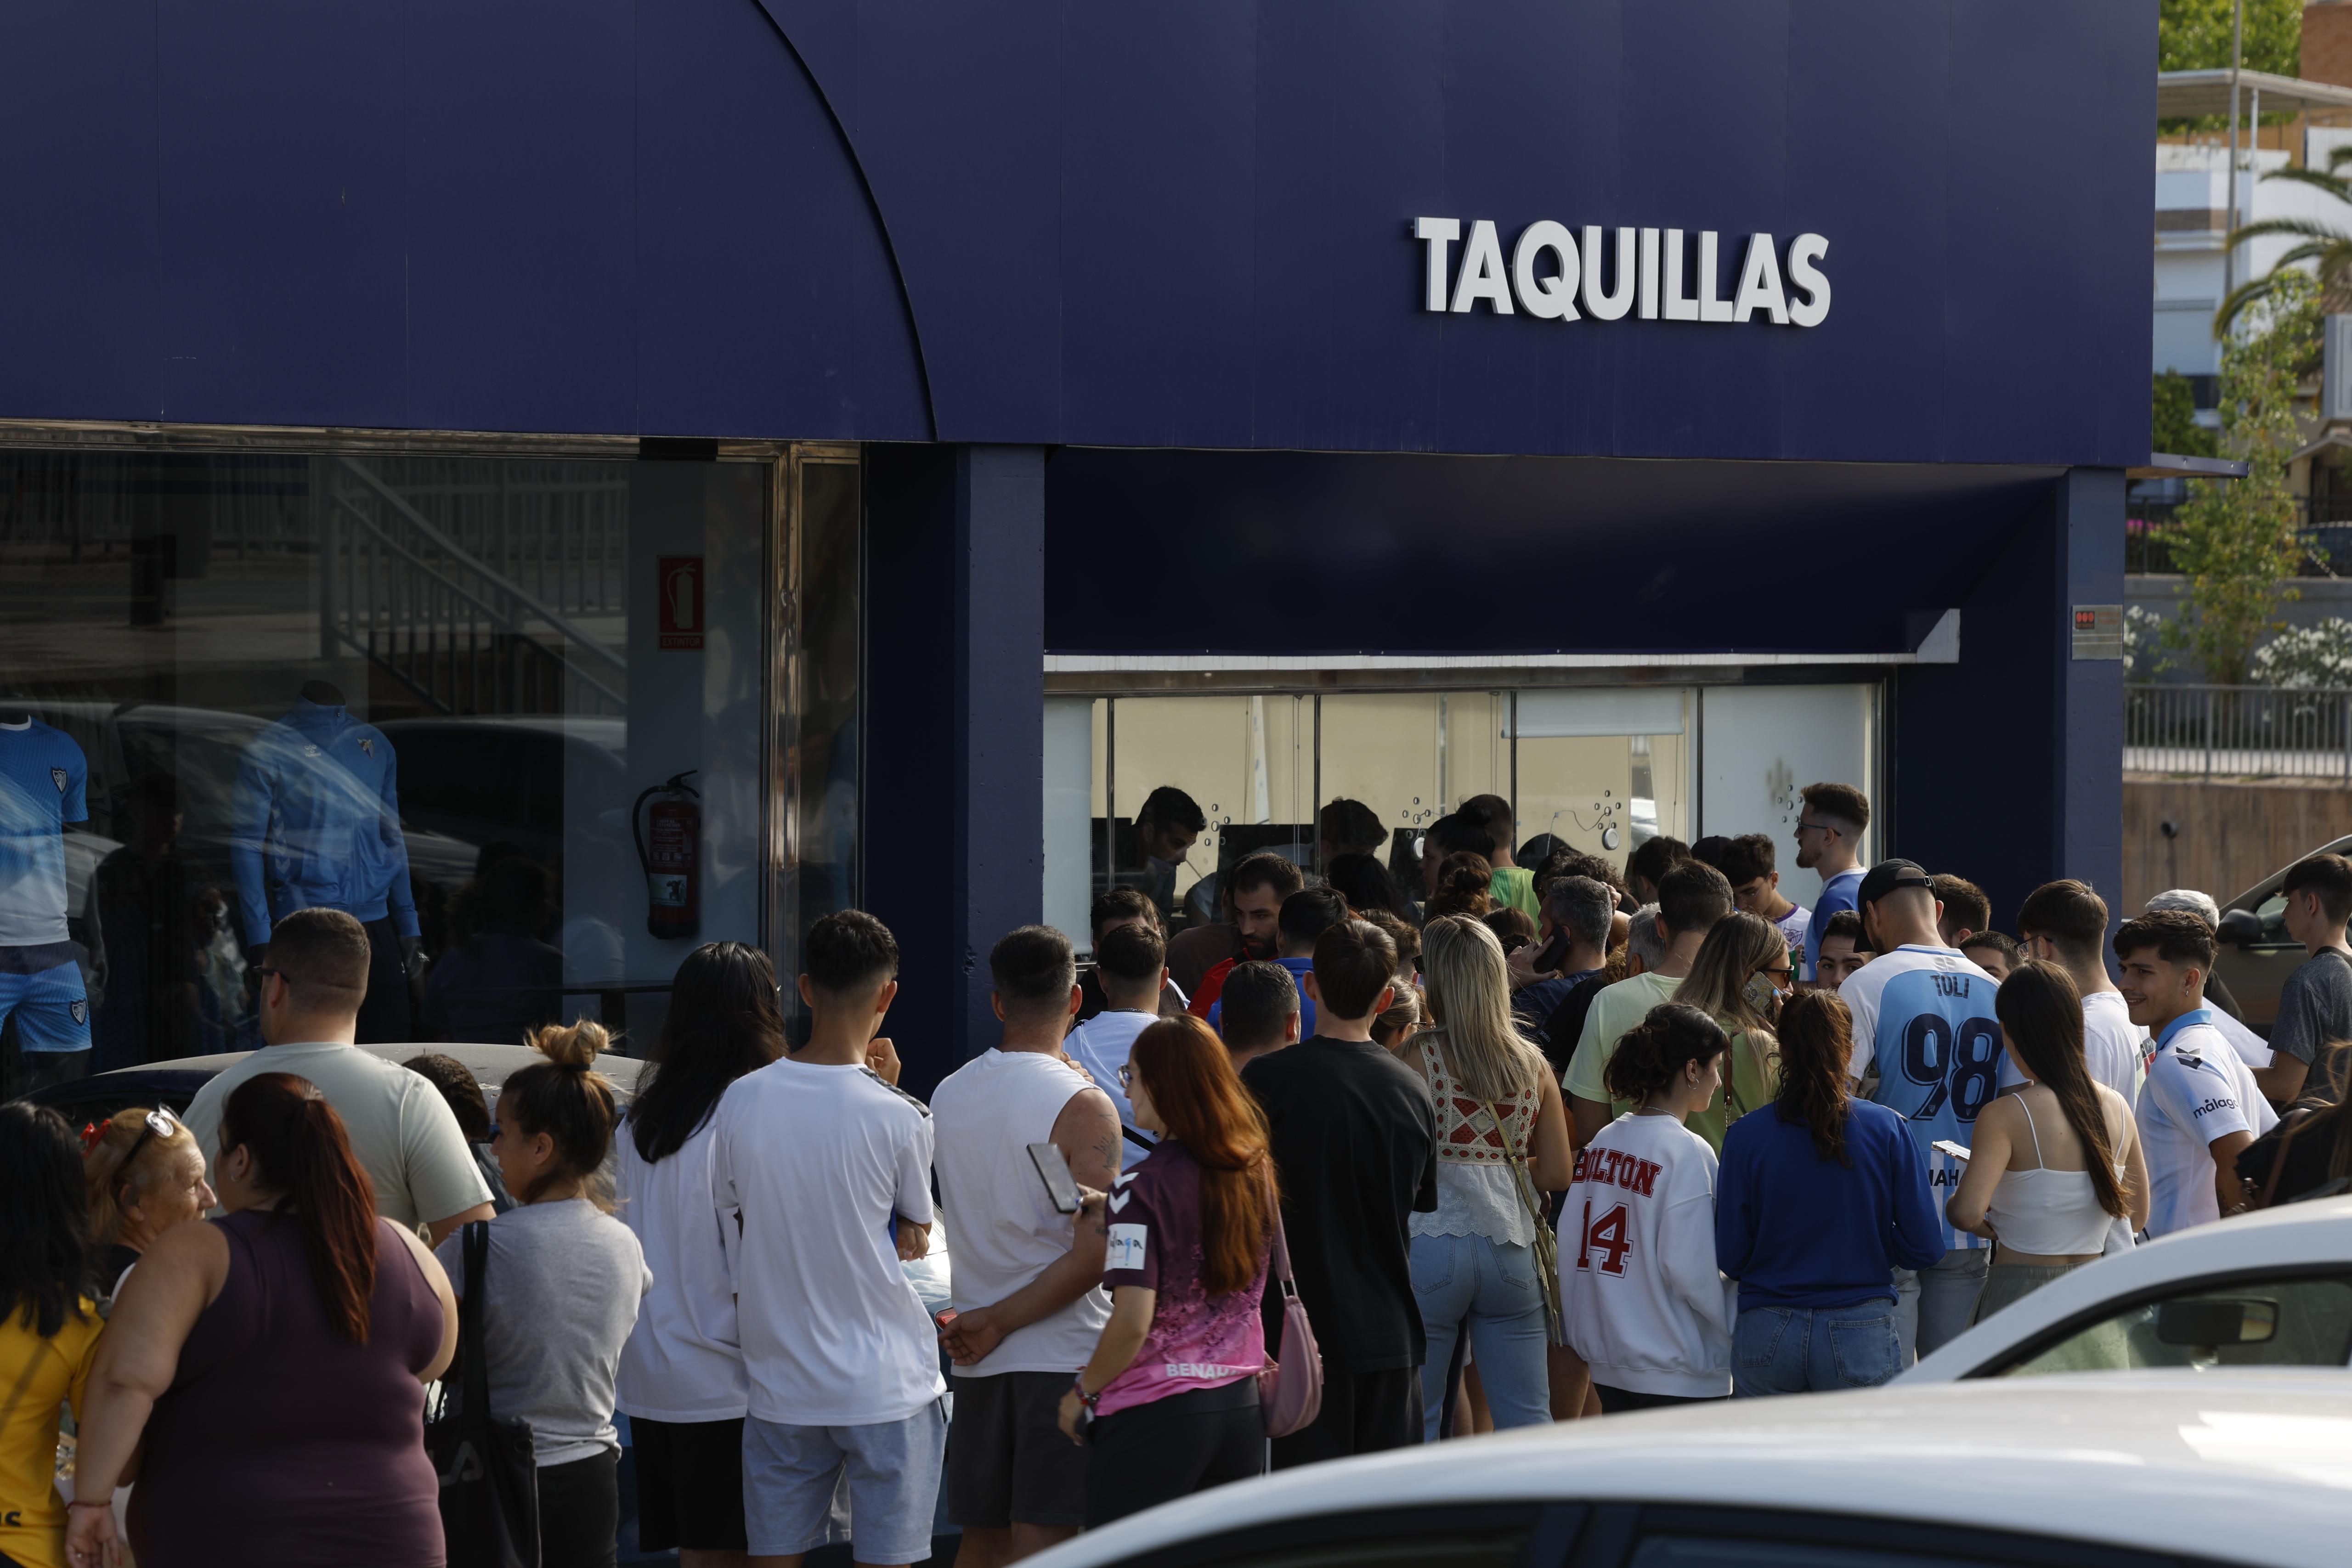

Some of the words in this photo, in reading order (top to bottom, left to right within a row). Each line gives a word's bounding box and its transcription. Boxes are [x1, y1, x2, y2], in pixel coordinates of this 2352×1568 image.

[1414, 217, 1831, 327] TAQUILLAS
[662, 637, 701, 647] EXTINTOR
[1929, 974, 1970, 999] TOLI
[1901, 1013, 2005, 1124] 98
[1577, 1196, 1634, 1279] 14
